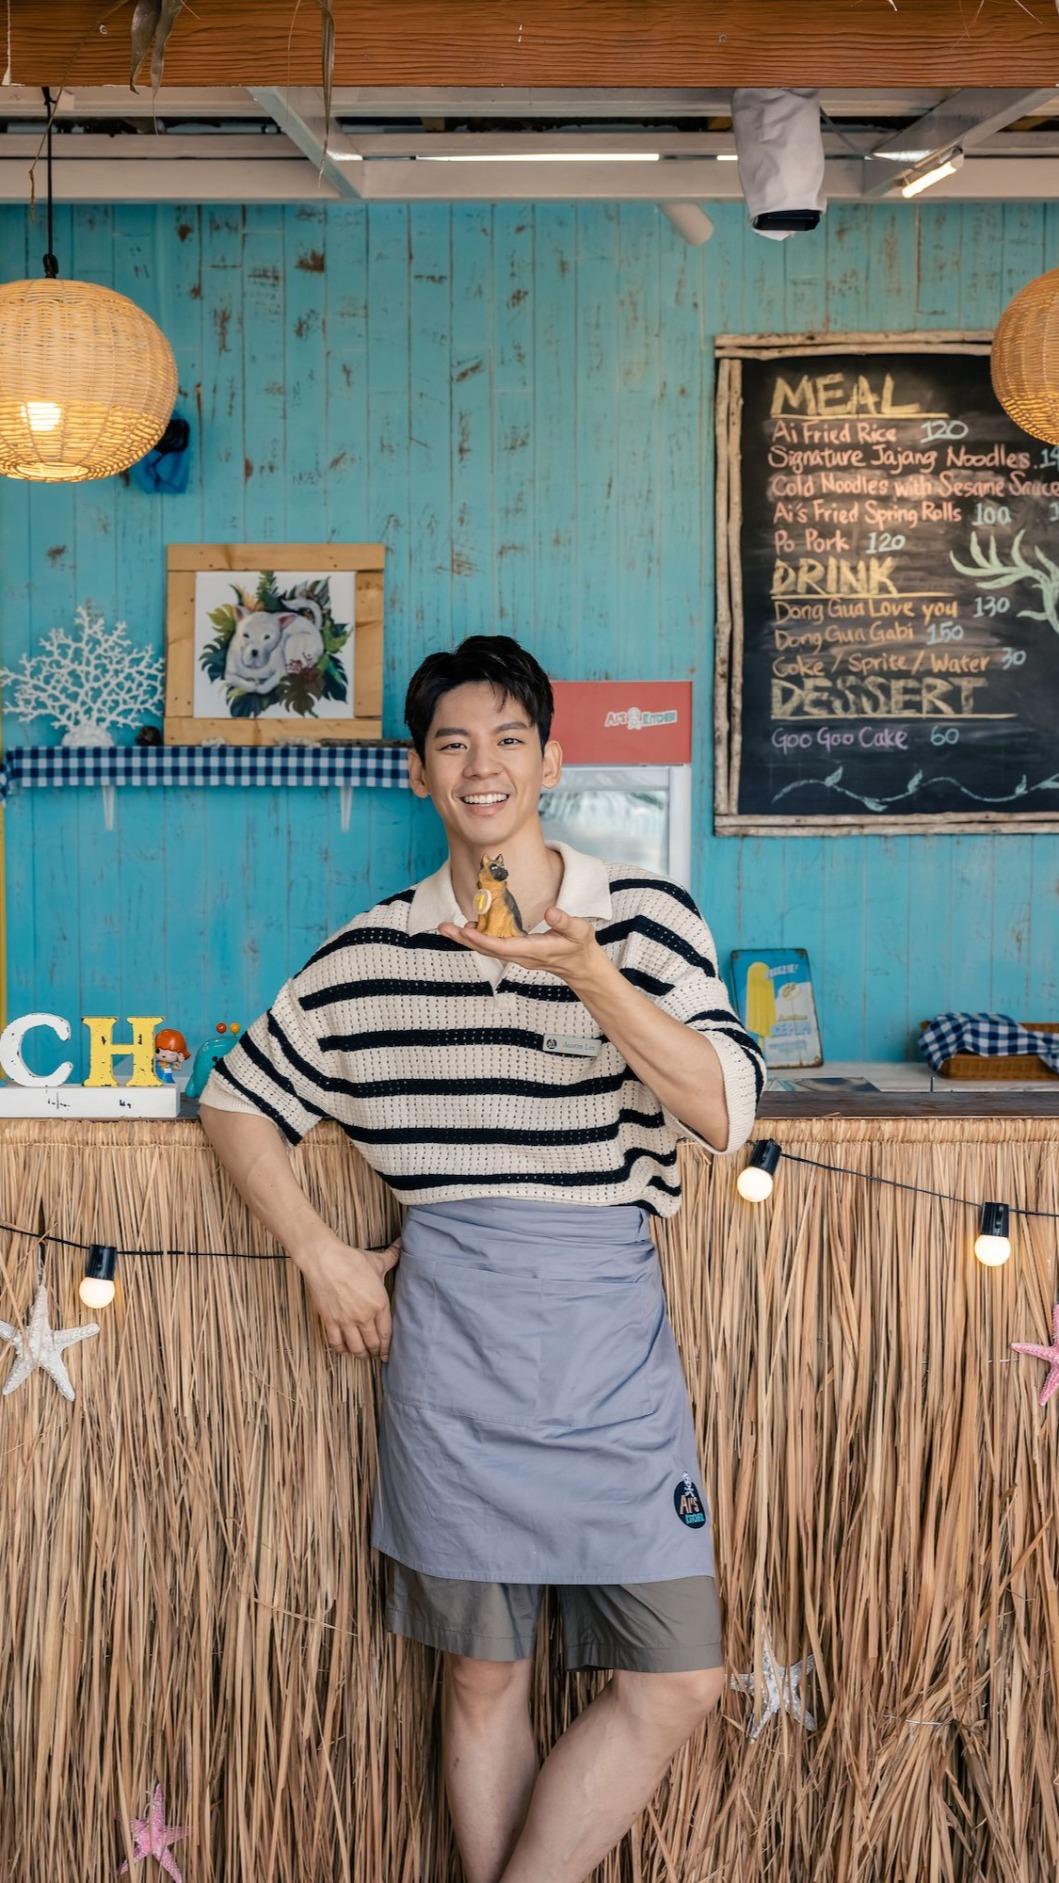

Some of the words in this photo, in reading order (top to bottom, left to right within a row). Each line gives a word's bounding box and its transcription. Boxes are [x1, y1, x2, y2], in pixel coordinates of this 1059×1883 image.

[770, 373, 920, 415] MEAL
[772, 422, 798, 444] Ai
[803, 421, 850, 443] Fried
[858, 421, 897, 441] Rice
[920, 420, 969, 443] 120
[768, 445, 869, 473] Signature
[871, 446, 938, 474] Jajang
[771, 474, 814, 497] Cold
[821, 472, 888, 496] Noodles
[893, 475, 932, 501] with
[940, 471, 1004, 498] Sesame
[1009, 472, 1059, 498] Sauce
[773, 502, 808, 523] Ai's
[813, 503, 858, 523] Fried
[864, 501, 917, 530] Spring
[921, 503, 962, 522] Rolls
[971, 503, 1012, 526] 100
[774, 531, 795, 552] Po
[805, 531, 850, 551] Pork
[865, 533, 906, 554] 120
[770, 556, 899, 595] DRINK
[773, 600, 823, 625] Dong
[869, 598, 914, 617] Love
[922, 599, 958, 623] you
[973, 597, 1010, 617] 130
[773, 629, 822, 653] Dong
[869, 621, 914, 643] Gabi
[926, 621, 964, 645] 150
[772, 656, 824, 677] Coke
[848, 653, 907, 673] Sprite
[930, 652, 990, 673] Water
[1001, 647, 1026, 669] 30
[770, 676, 988, 717] DESSERT
[772, 727, 812, 754] Goo
[817, 727, 854, 753] Goo
[859, 727, 908, 750] Cake
[930, 725, 960, 746] 60
